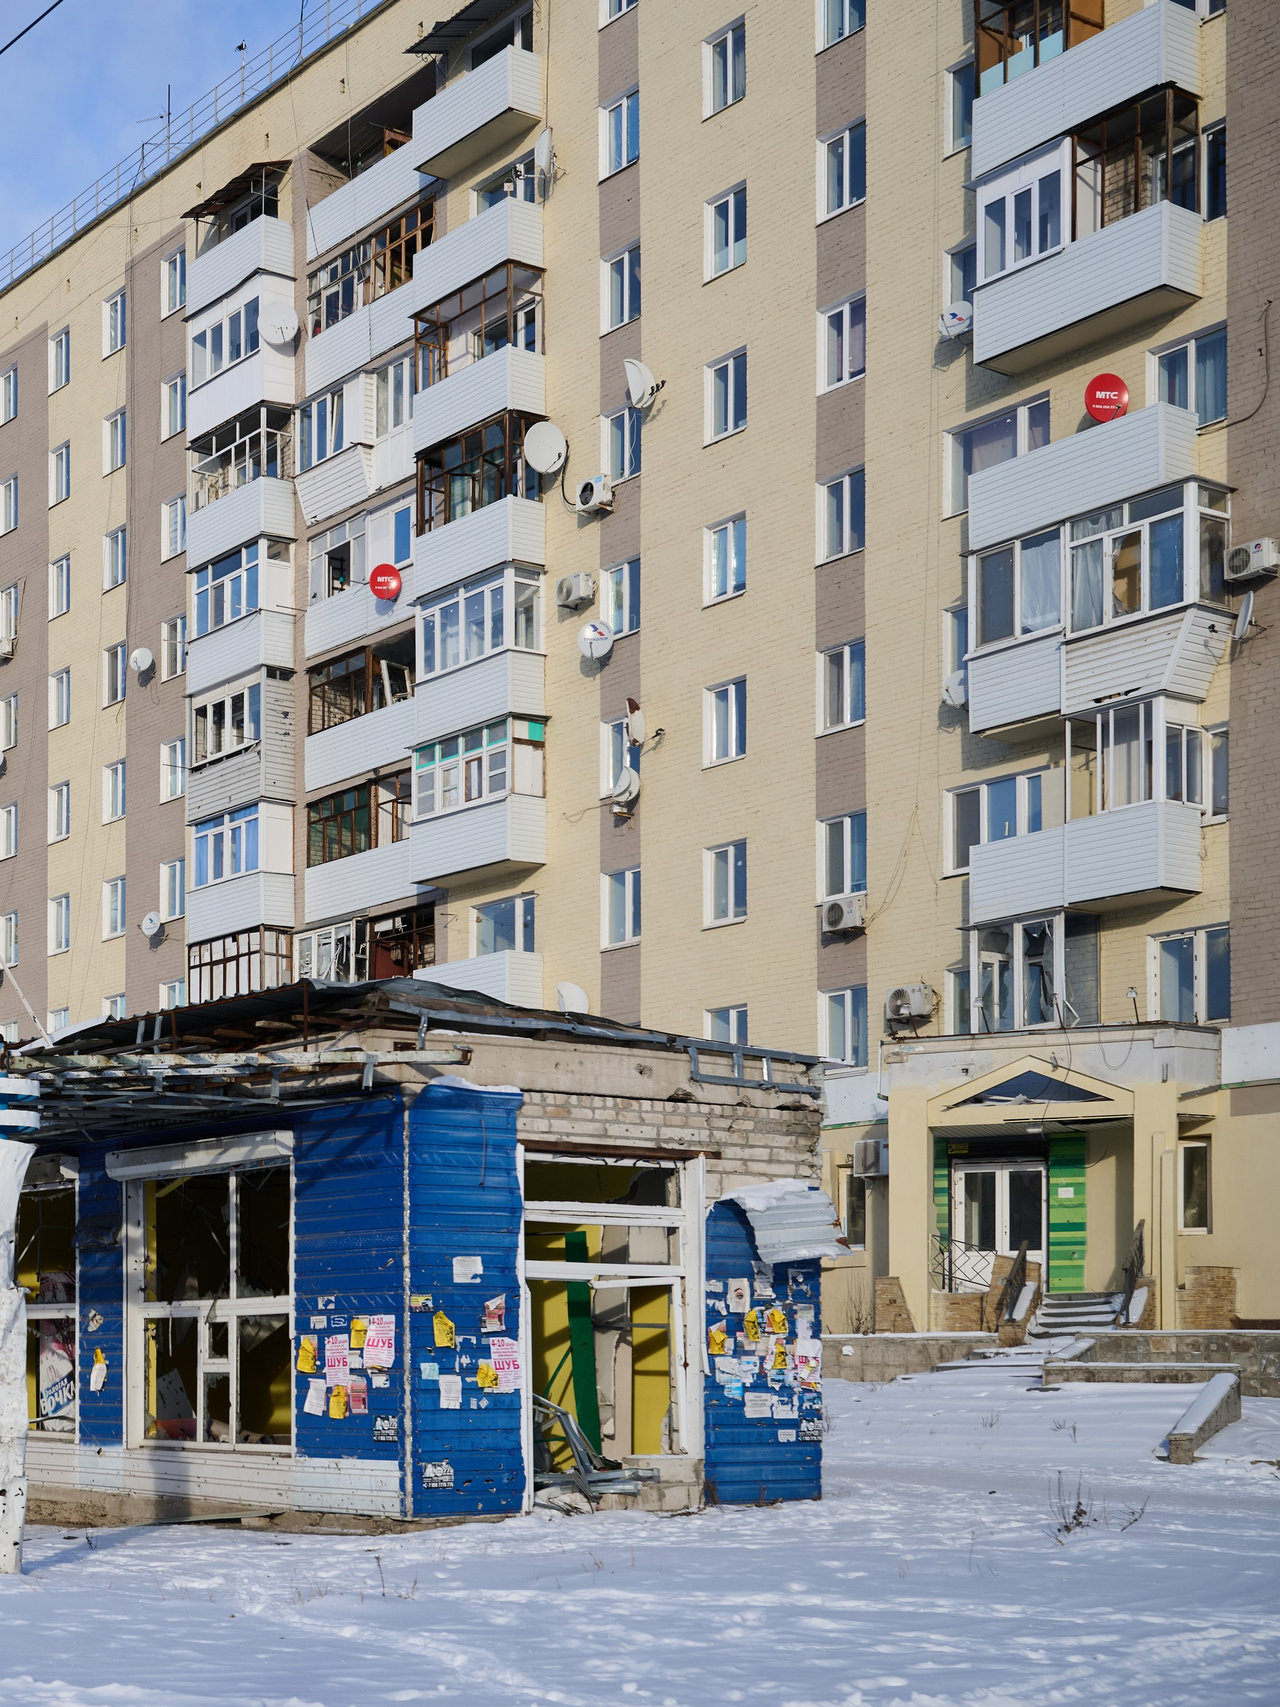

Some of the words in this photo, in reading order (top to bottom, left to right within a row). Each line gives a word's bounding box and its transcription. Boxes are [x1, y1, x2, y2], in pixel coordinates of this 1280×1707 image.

[366, 1338, 393, 1348] ШУБ
[327, 1357, 348, 1368] ШУБ
[493, 1360, 520, 1370] ШУБ
